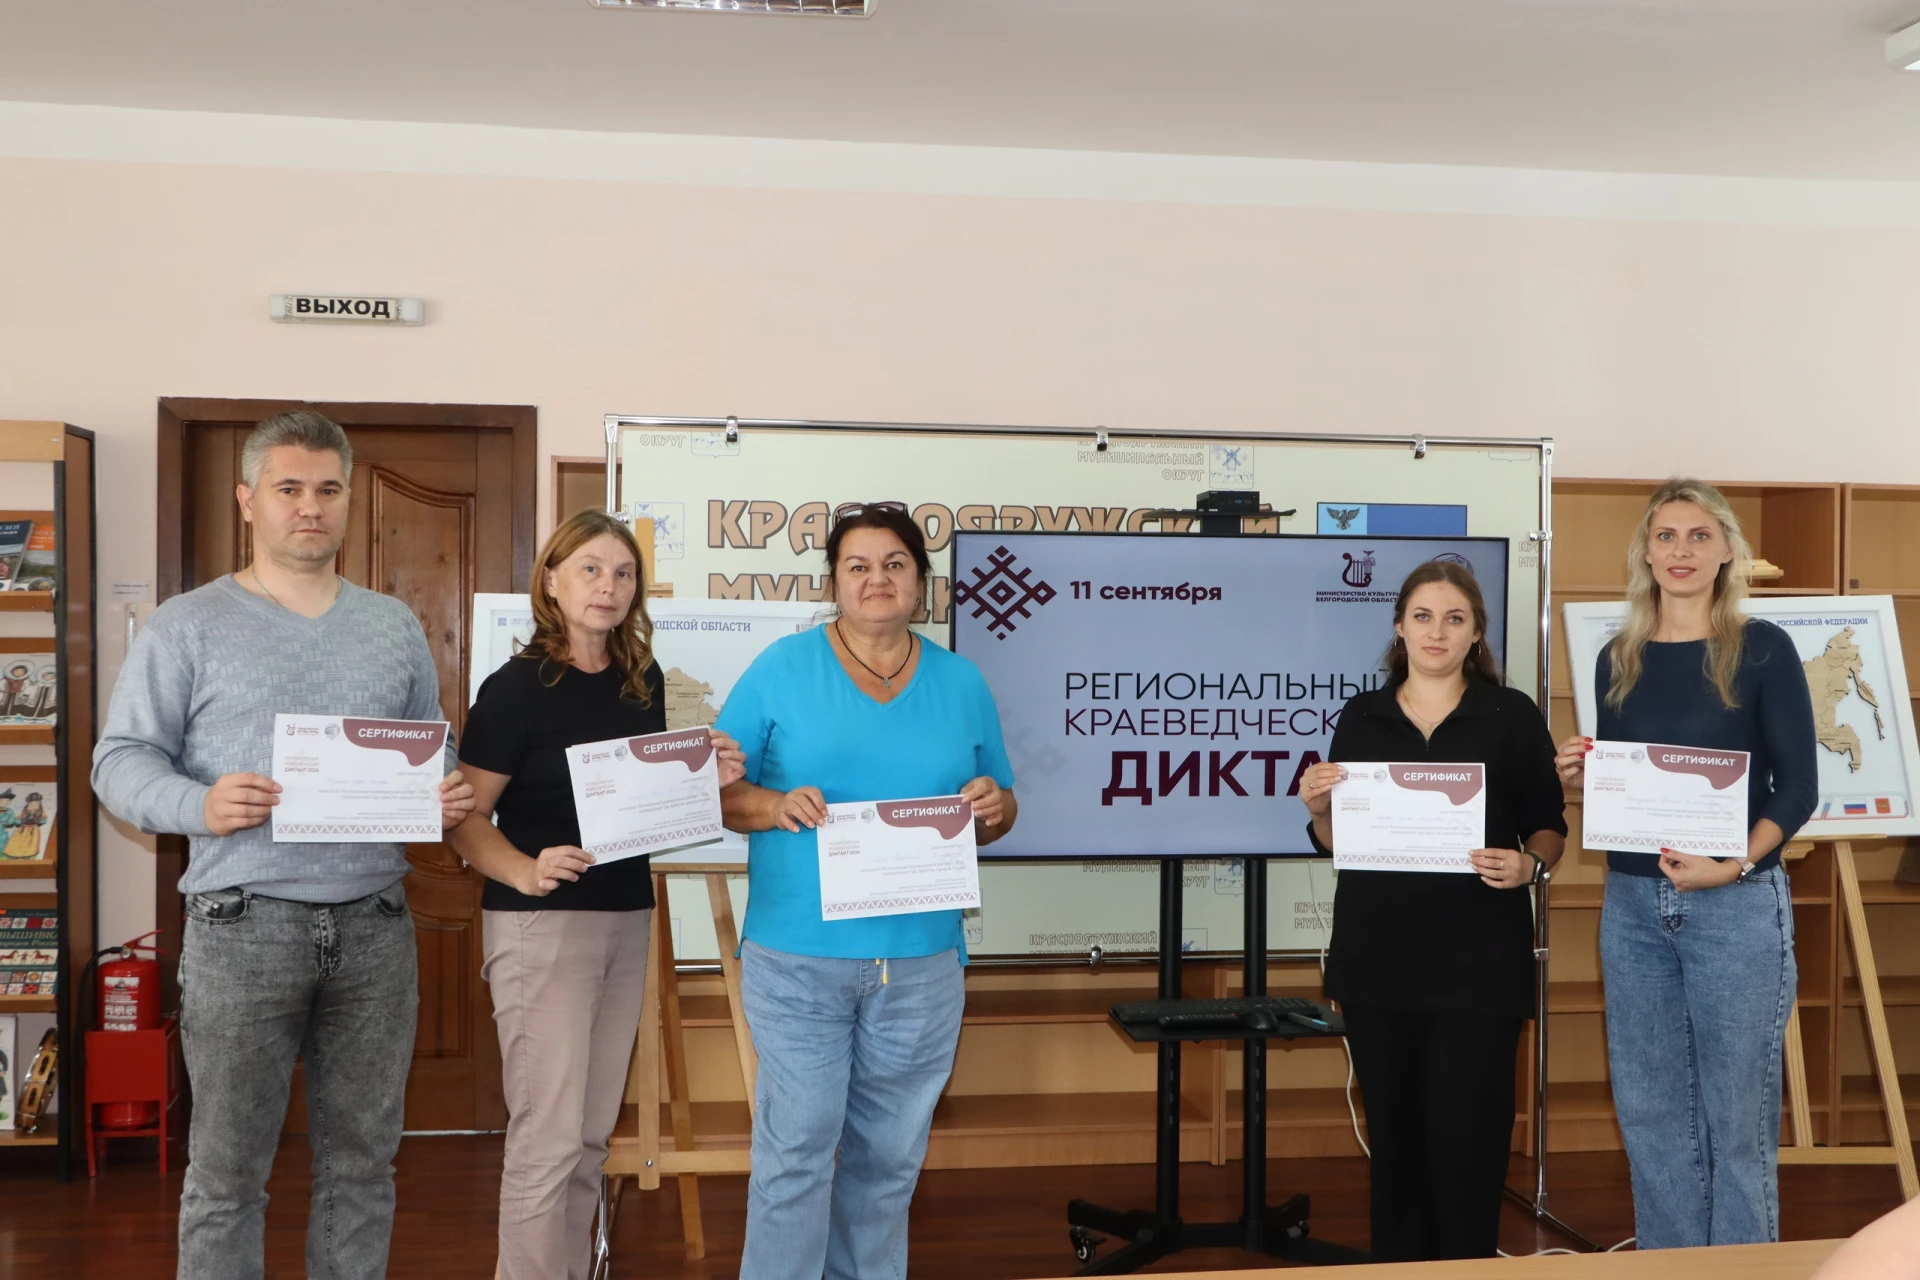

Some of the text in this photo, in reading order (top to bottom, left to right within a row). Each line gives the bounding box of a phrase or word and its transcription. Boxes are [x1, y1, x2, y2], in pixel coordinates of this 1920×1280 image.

[296, 298, 390, 318] ВЫХОД
[640, 434, 686, 448] ОКРУГ
[1078, 451, 1204, 465] МУНИЦИПАЛЬНЫЙ
[1162, 468, 1204, 482] ОКРУГ
[1070, 581, 1222, 605] 11 сентября
[652, 619, 751, 632] ОДСКОЙ ОБЛАСТИ
[1777, 617, 1868, 627] РОССИЙСКОЙ ФЕДЕРАЦИИ
[1065, 708, 1342, 740] КРАЕВЕДЧЕСК
[358, 728, 434, 740] СЕРТИФИКАТ
[643, 736, 705, 754] СЕРТИФИКАТ
[1662, 754, 1736, 767] СЕРТИФИКАТ
[1101, 750, 1325, 806] ДИКТА
[1403, 772, 1472, 782] СЕРТИФИКАТ
[892, 805, 961, 819] СЕРТИФИКАТ
[1029, 931, 1157, 946] КРАСНОЯРУЖСКИЙ
